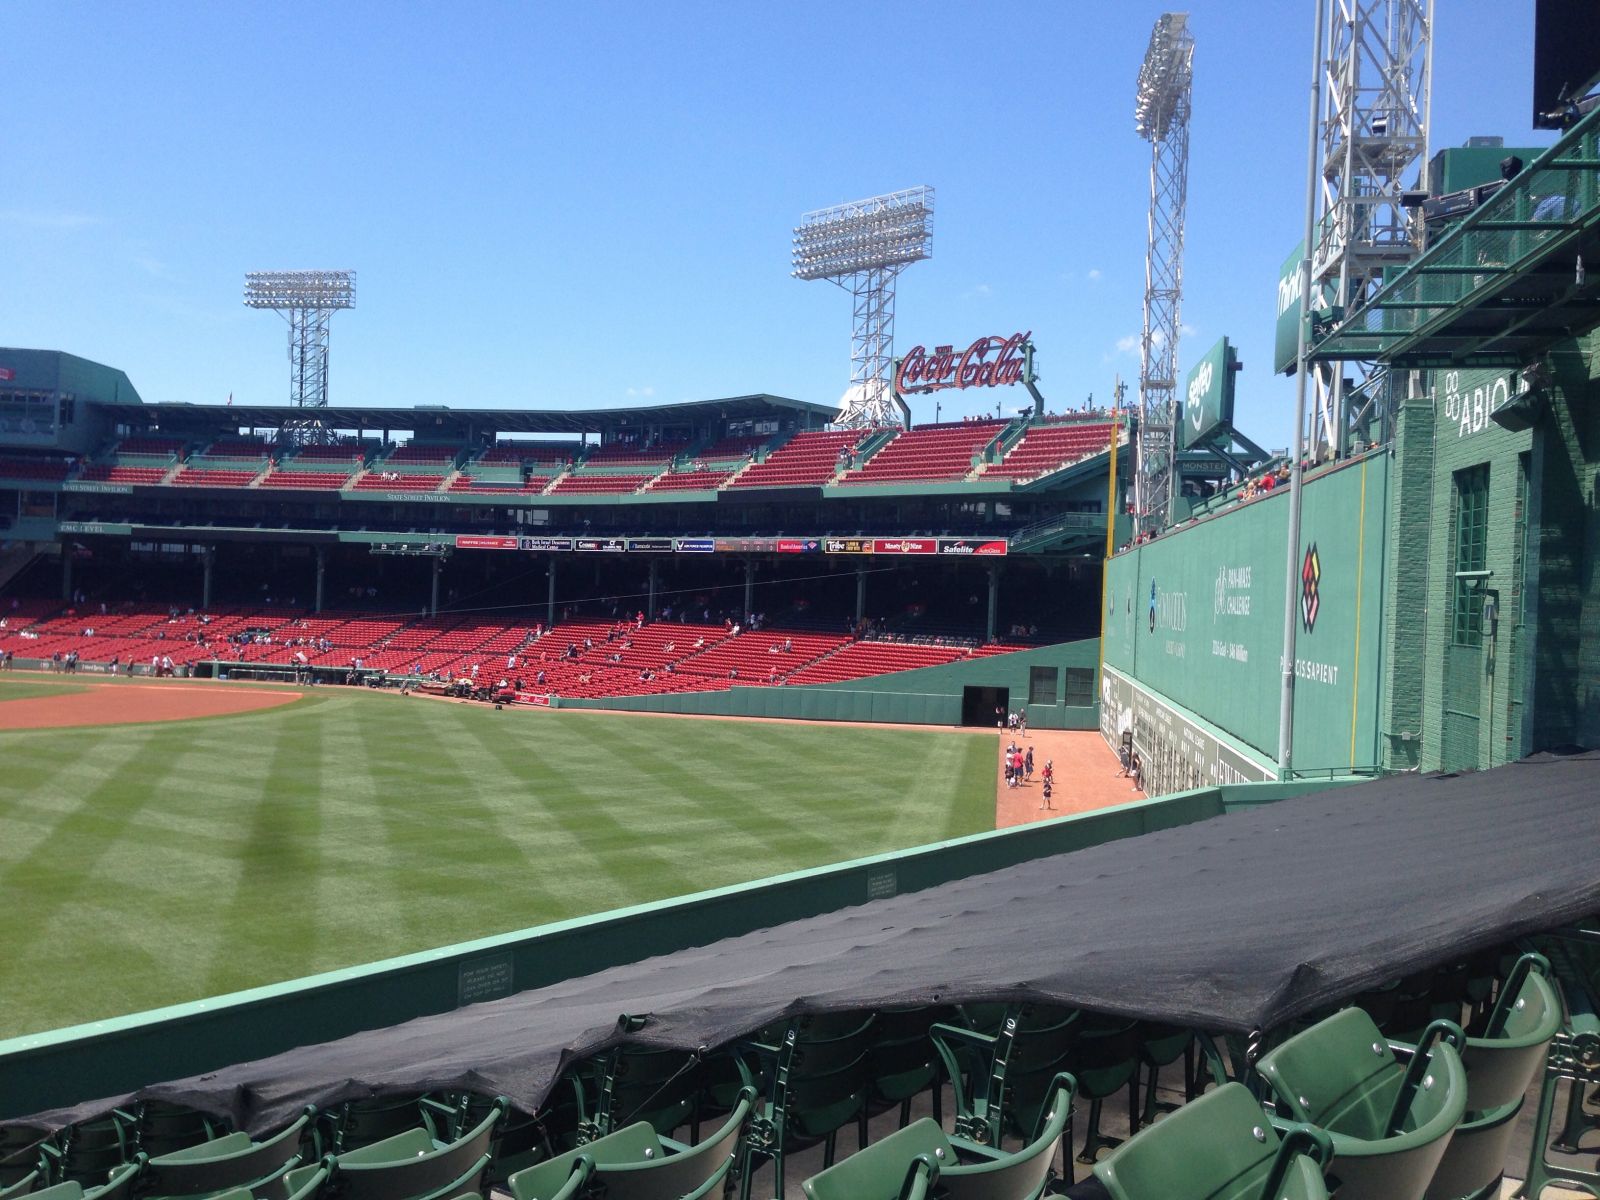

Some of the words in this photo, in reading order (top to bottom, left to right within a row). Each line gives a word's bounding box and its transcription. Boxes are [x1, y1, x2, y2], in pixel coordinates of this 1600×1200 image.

[895, 331, 1031, 394] Coca-Cola
[827, 541, 845, 551] Tribe
[943, 545, 974, 553] Safelite
